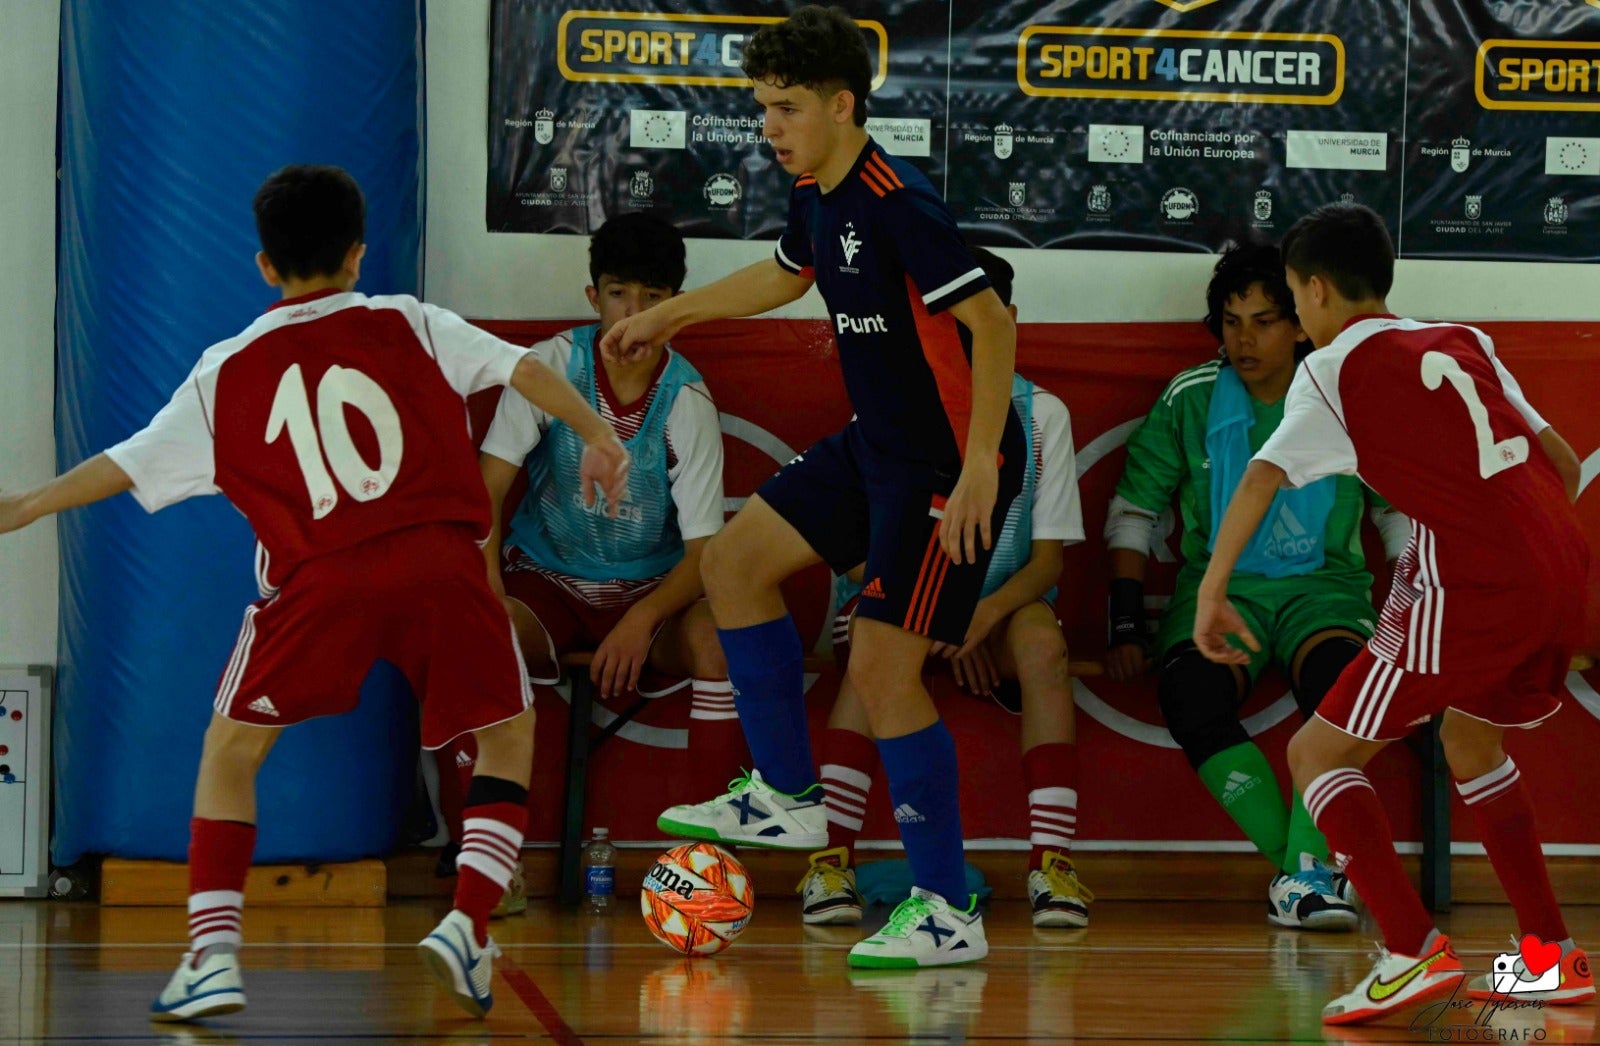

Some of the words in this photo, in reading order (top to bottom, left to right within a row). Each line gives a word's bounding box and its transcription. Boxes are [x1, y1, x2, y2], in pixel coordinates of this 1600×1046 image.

[580, 29, 747, 67] SPORT4C
[1039, 44, 1321, 86] SPORT4CANCER
[505, 119, 533, 129] Región
[568, 121, 596, 129] Murcia
[692, 115, 766, 129] Cofinanciad
[692, 133, 703, 142] la
[707, 132, 743, 144] Unión
[893, 134, 924, 142] MURCIA
[964, 133, 992, 143] Región
[1015, 135, 1026, 143] de
[1027, 135, 1054, 144] Murcia
[1150, 129, 1231, 143] Cofinanciado
[1234, 134, 1256, 146] por
[1318, 138, 1369, 147] UNIVERSIDAD
[1149, 145, 1161, 156] la
[1164, 145, 1200, 157] Unión
[1203, 147, 1255, 161] Europea
[1350, 148, 1380, 156] MURCIA
[1421, 147, 1449, 157] Región
[1472, 148, 1483, 156] de
[1484, 148, 1511, 157] Murcia
[836, 313, 888, 335] Punt
[1420, 350, 1530, 480] 2
[264, 362, 404, 520] 10
[649, 861, 695, 900] oma
